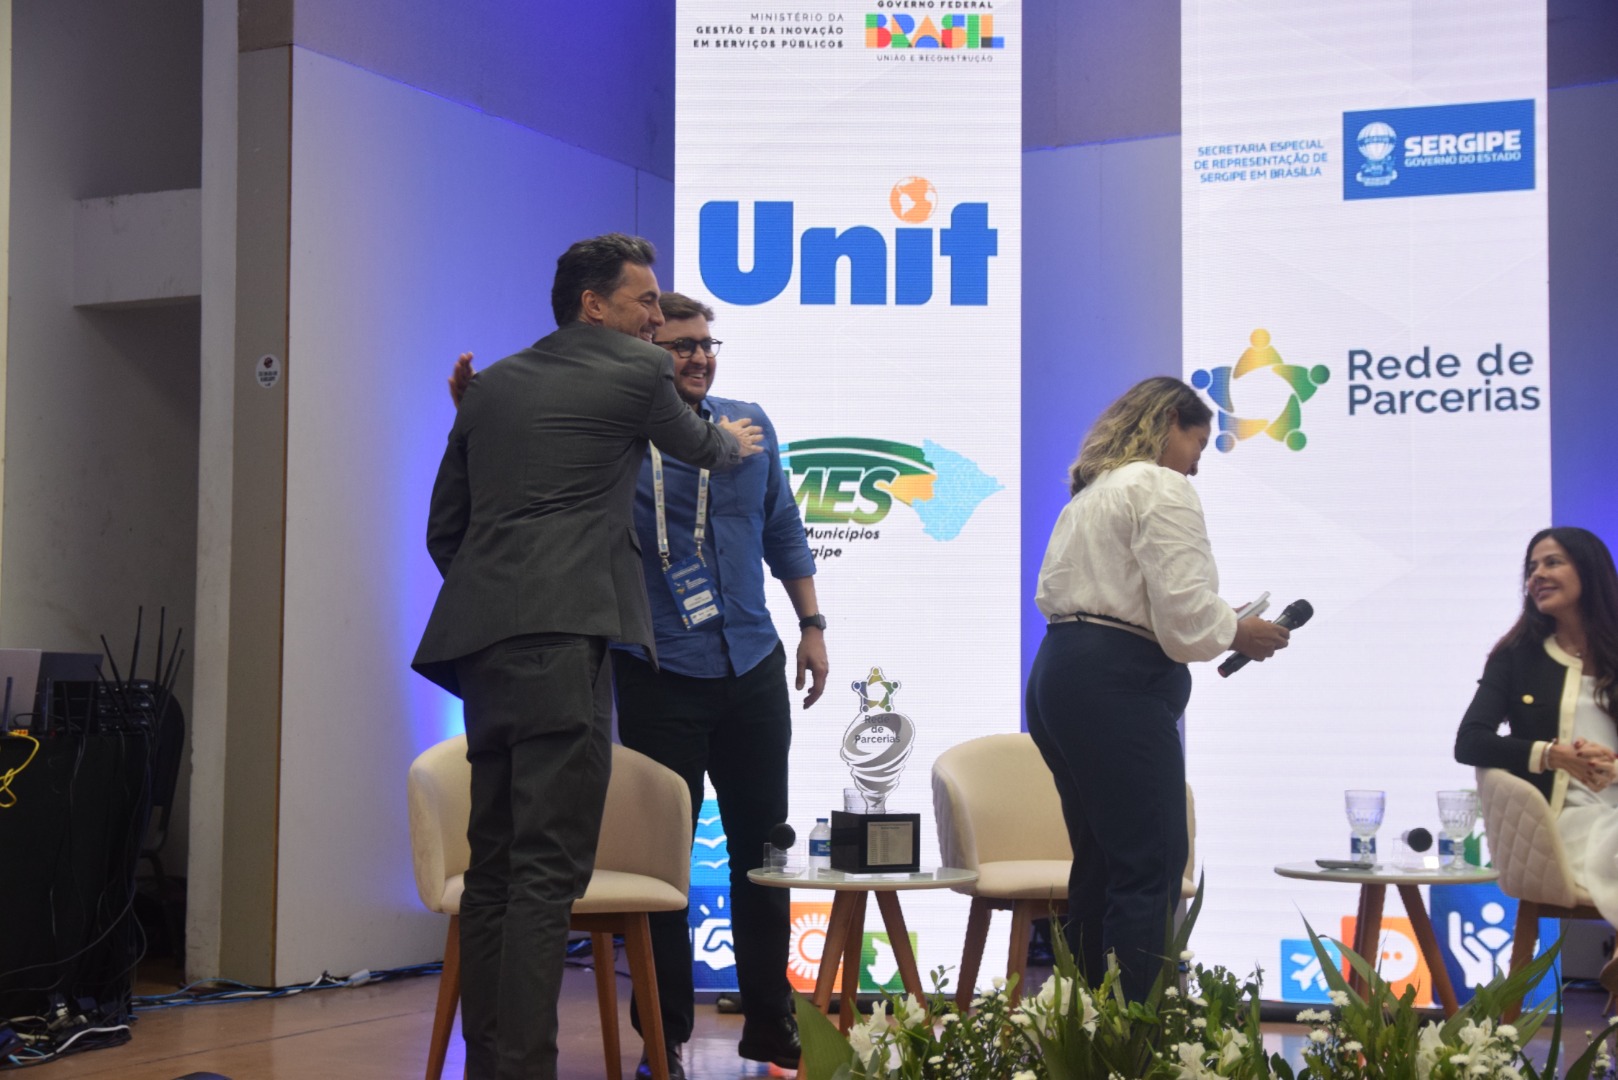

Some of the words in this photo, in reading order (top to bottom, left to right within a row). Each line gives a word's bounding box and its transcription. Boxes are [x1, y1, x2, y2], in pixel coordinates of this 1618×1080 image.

[877, 0, 935, 9] GOVERNO
[940, 0, 994, 9] FEDERAL
[750, 12, 823, 22] MINISTÉRIO
[828, 13, 844, 22] DA
[696, 24, 744, 35] GESTÃO
[749, 26, 755, 35] E
[761, 26, 776, 35] DA
[781, 24, 844, 36] INOVAÇÃO
[865, 13, 1004, 48] BRASIL
[693, 39, 709, 48] EM
[715, 39, 776, 49] SERVIÇOS
[781, 38, 844, 49] PÚBLICOS
[876, 53, 906, 62] UNIÃO
[910, 54, 915, 62] E
[919, 53, 994, 63] RECONSTRUÇÃO
[1198, 143, 1266, 157] SECRETARIA
[1270, 139, 1324, 152] ESPECIAL
[1404, 129, 1522, 157] SERGIPE
[1194, 159, 1208, 170] DE
[1212, 152, 1310, 169] REPRESENTAÇÃO
[1313, 152, 1328, 163] DE
[1404, 155, 1457, 168] GOVERNO
[1459, 153, 1476, 165] DO
[1477, 151, 1522, 164] ESTADO
[1200, 170, 1247, 183] SERGIPE
[1250, 169, 1267, 180] EM
[1270, 165, 1322, 179] BRASÍLIA
[699, 176, 998, 306] Unit
[1348, 346, 1461, 381] Rede
[1477, 343, 1534, 377] de
[1349, 379, 1541, 416] Parcerias
[811, 545, 842, 560] gipe
[864, 714, 890, 723] Rede
[871, 725, 884, 733] de
[855, 734, 901, 744] Parcerias
